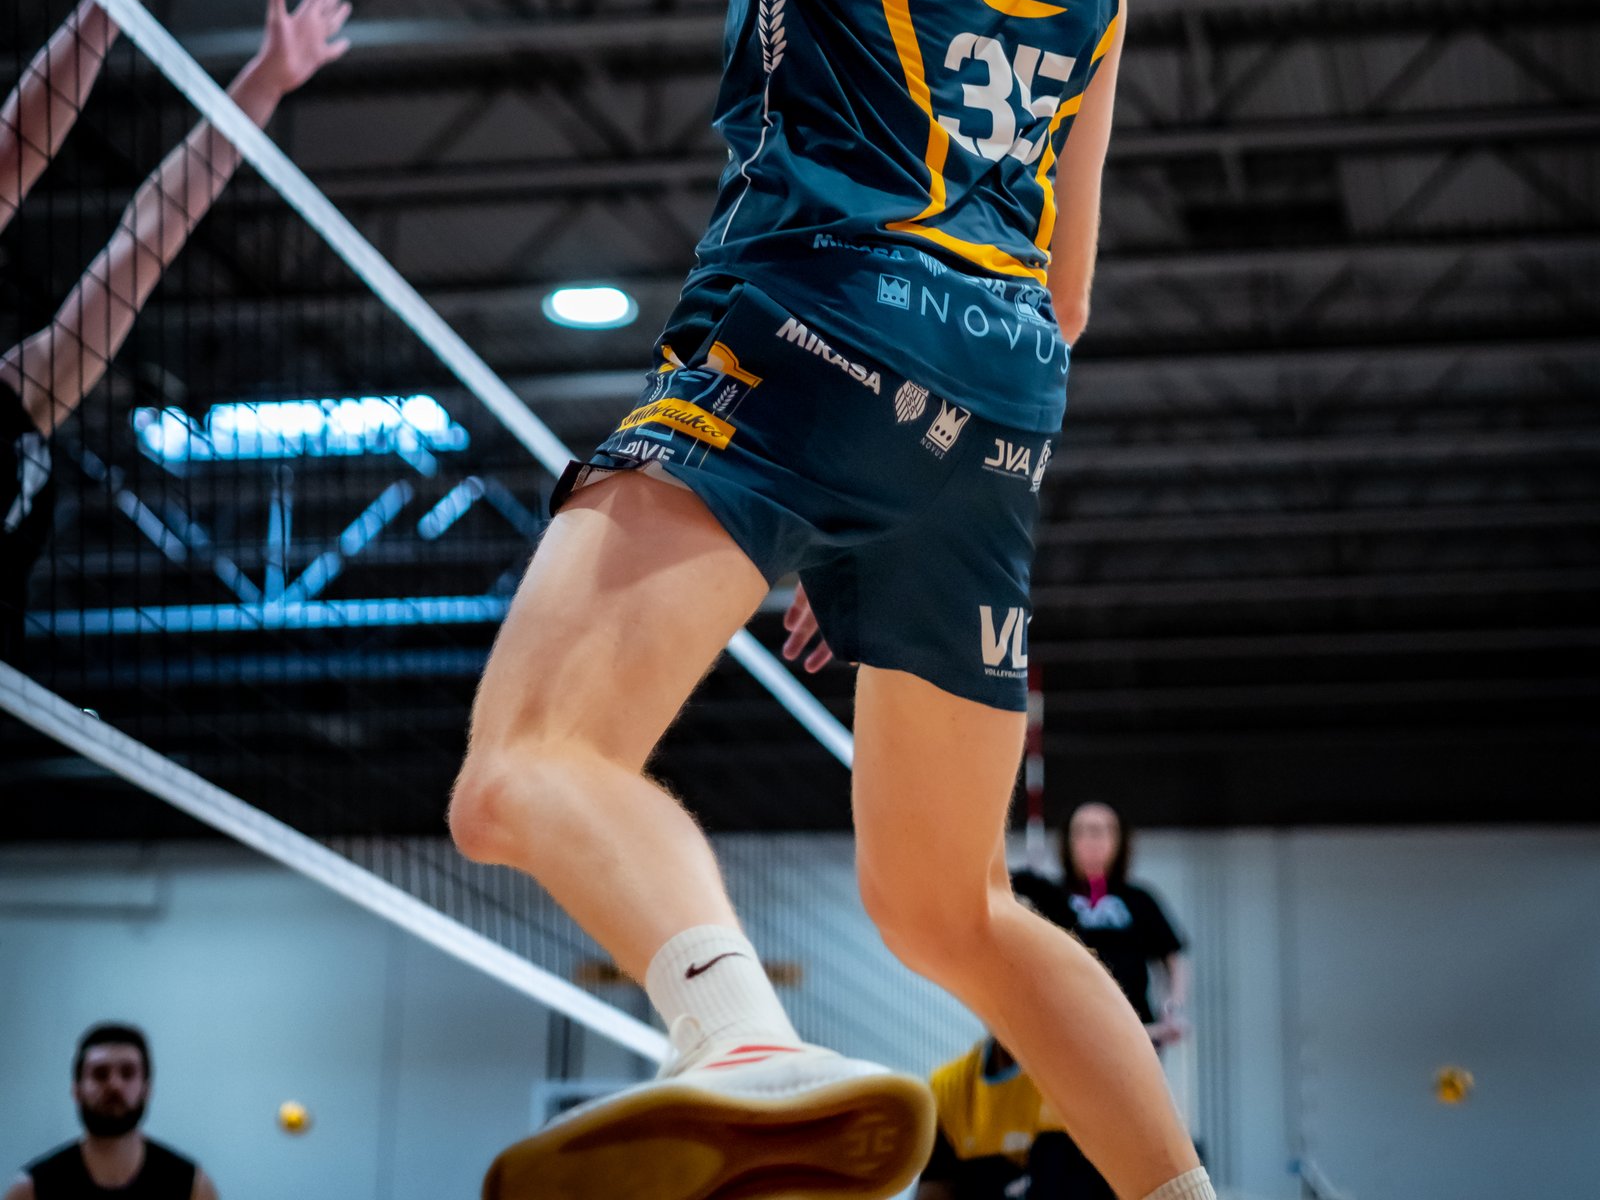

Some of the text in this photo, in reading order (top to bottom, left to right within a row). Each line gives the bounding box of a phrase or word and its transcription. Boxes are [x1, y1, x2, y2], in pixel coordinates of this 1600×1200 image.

[937, 32, 1077, 166] 35
[775, 317, 882, 396] MIKASA
[920, 285, 1072, 375] NOVUS
[920, 436, 946, 461] NOVUS
[984, 438, 1031, 476] JVA
